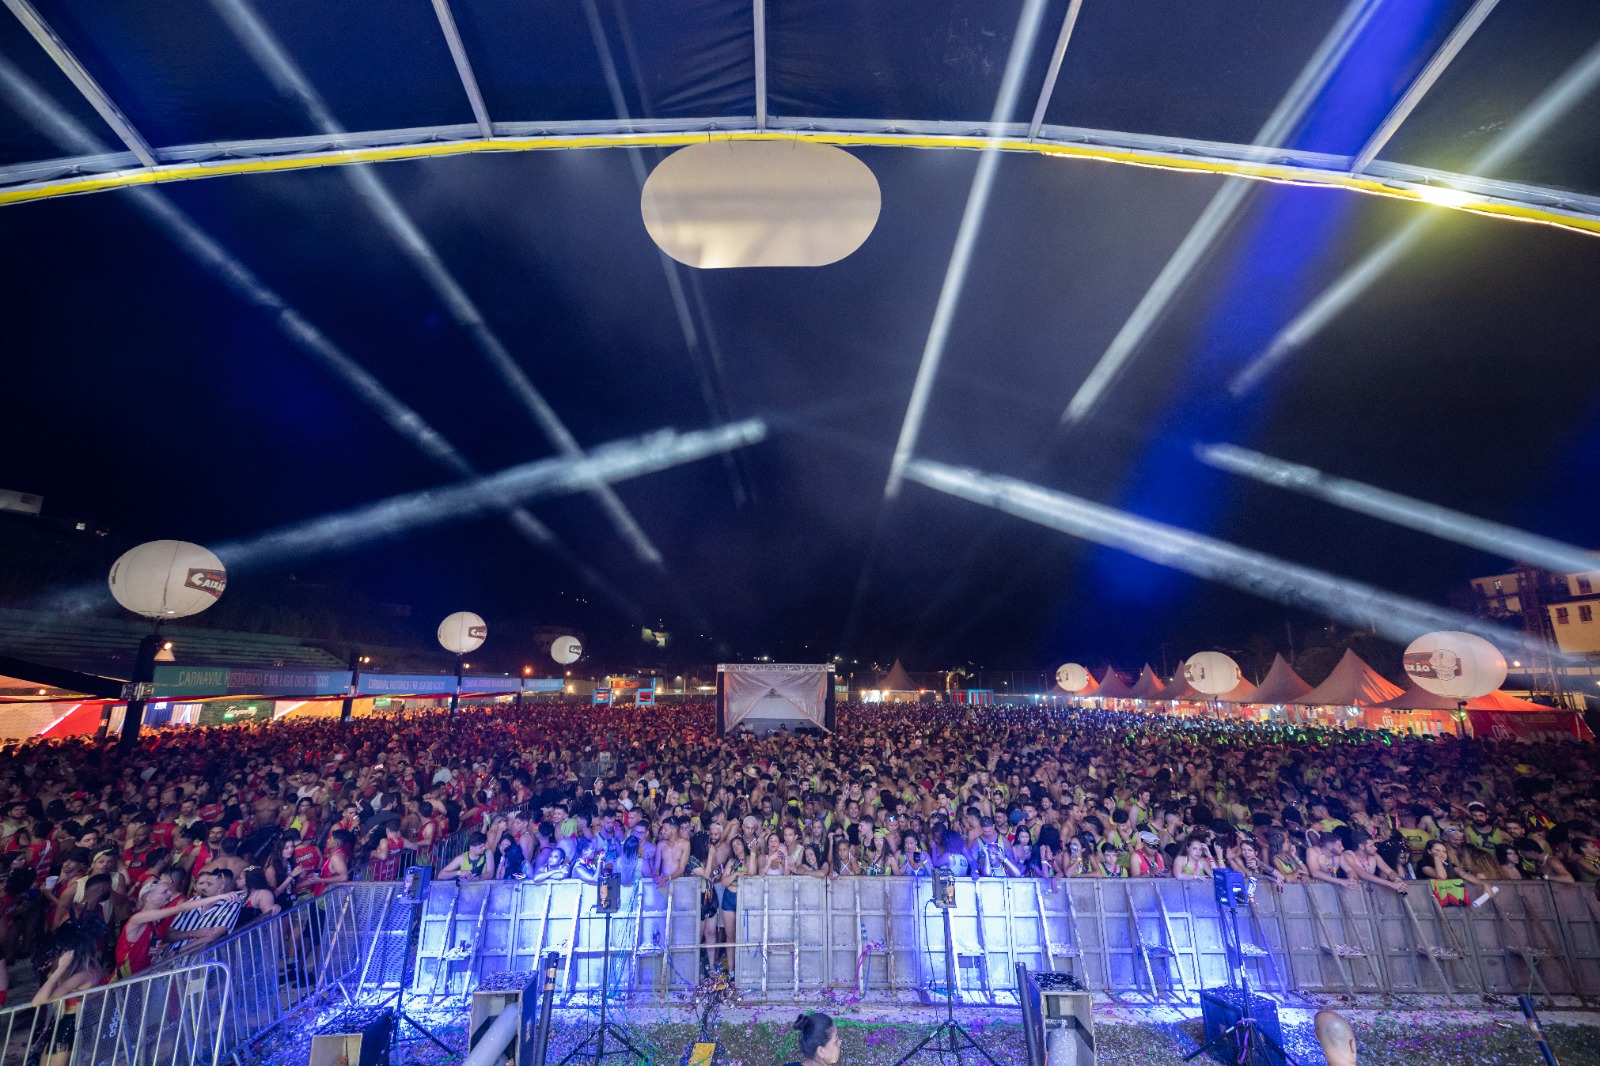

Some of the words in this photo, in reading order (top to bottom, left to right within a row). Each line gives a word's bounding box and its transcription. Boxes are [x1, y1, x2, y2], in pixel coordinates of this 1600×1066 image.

[179, 671, 222, 686] CARNAVAL
[224, 671, 262, 687] HISTÓRICO
[280, 674, 294, 688] LIGA
